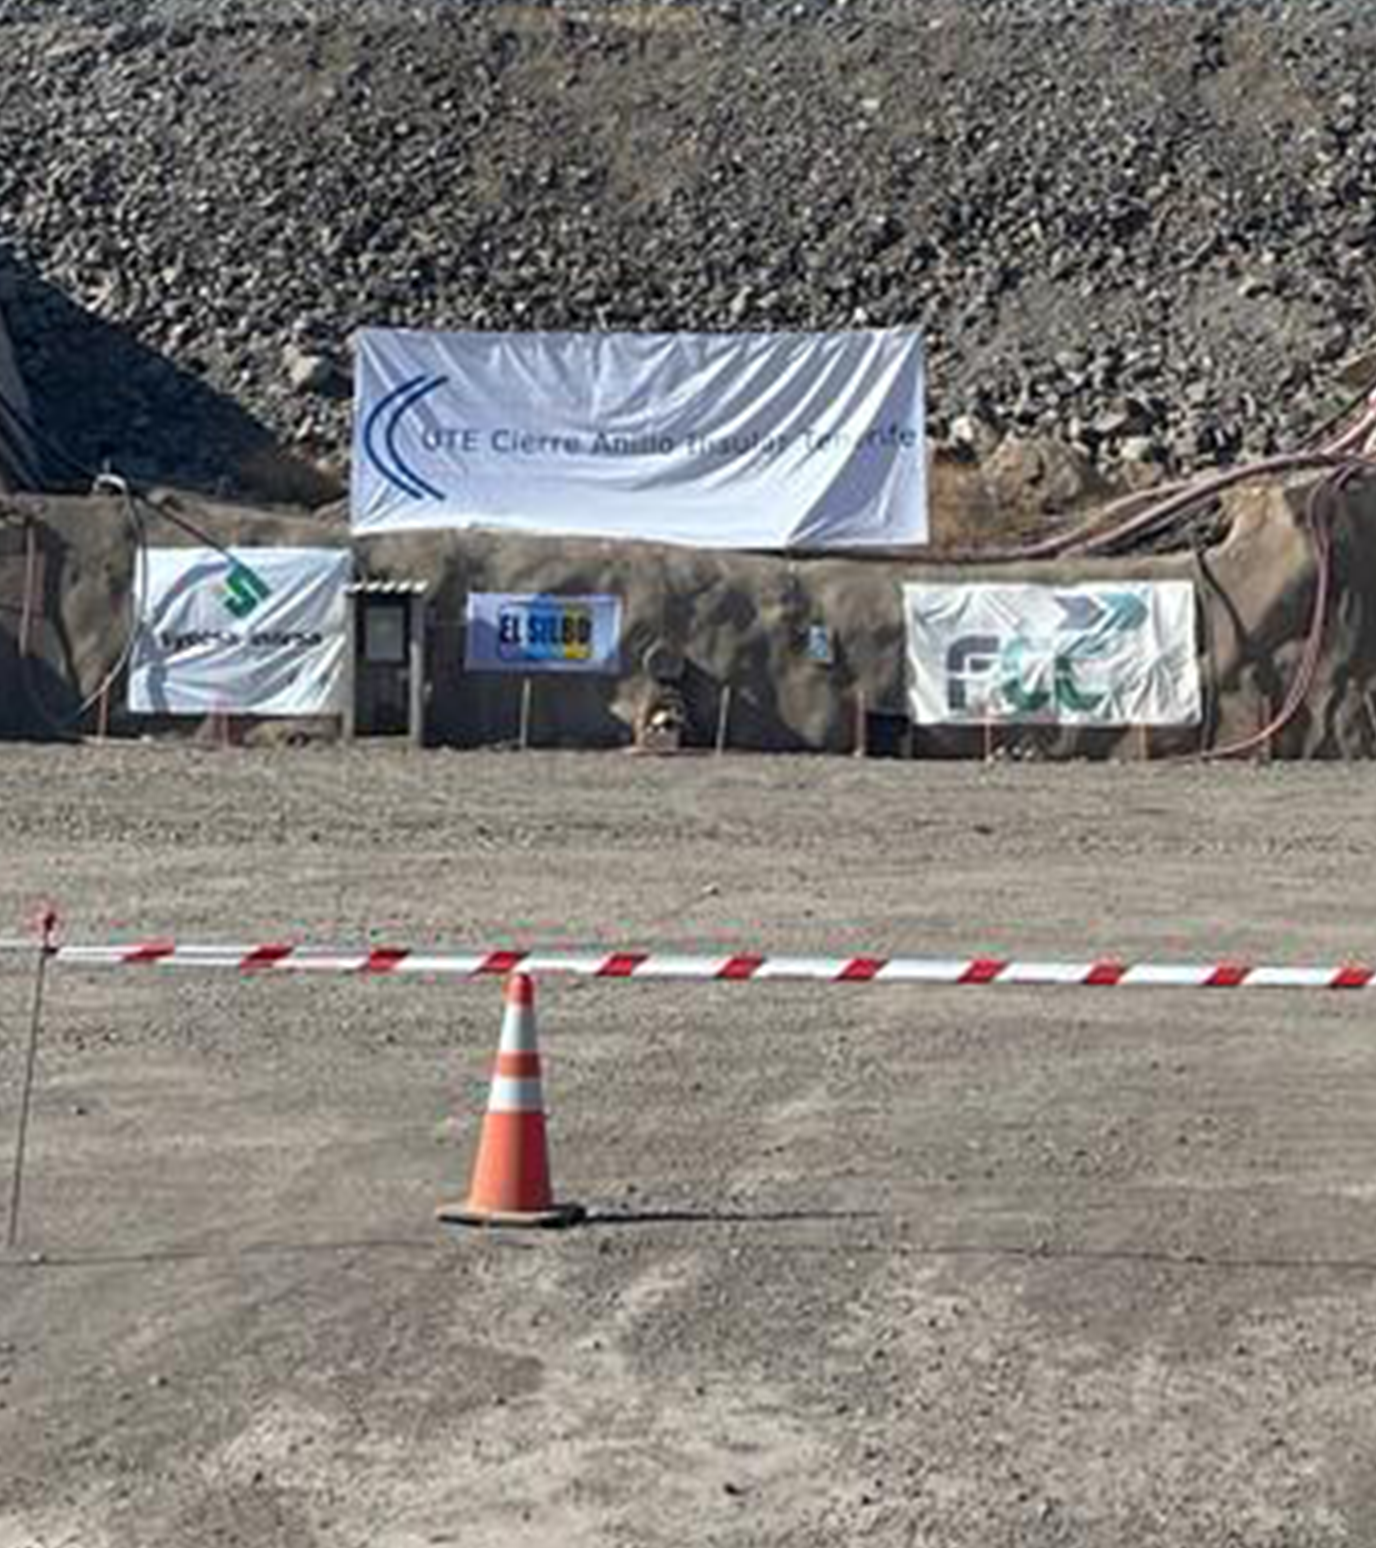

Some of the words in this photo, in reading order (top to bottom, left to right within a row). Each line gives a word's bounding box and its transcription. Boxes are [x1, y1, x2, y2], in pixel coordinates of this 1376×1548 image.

[423, 428, 479, 453] UTE
[490, 428, 580, 453] Cierre
[499, 612, 522, 645] EL
